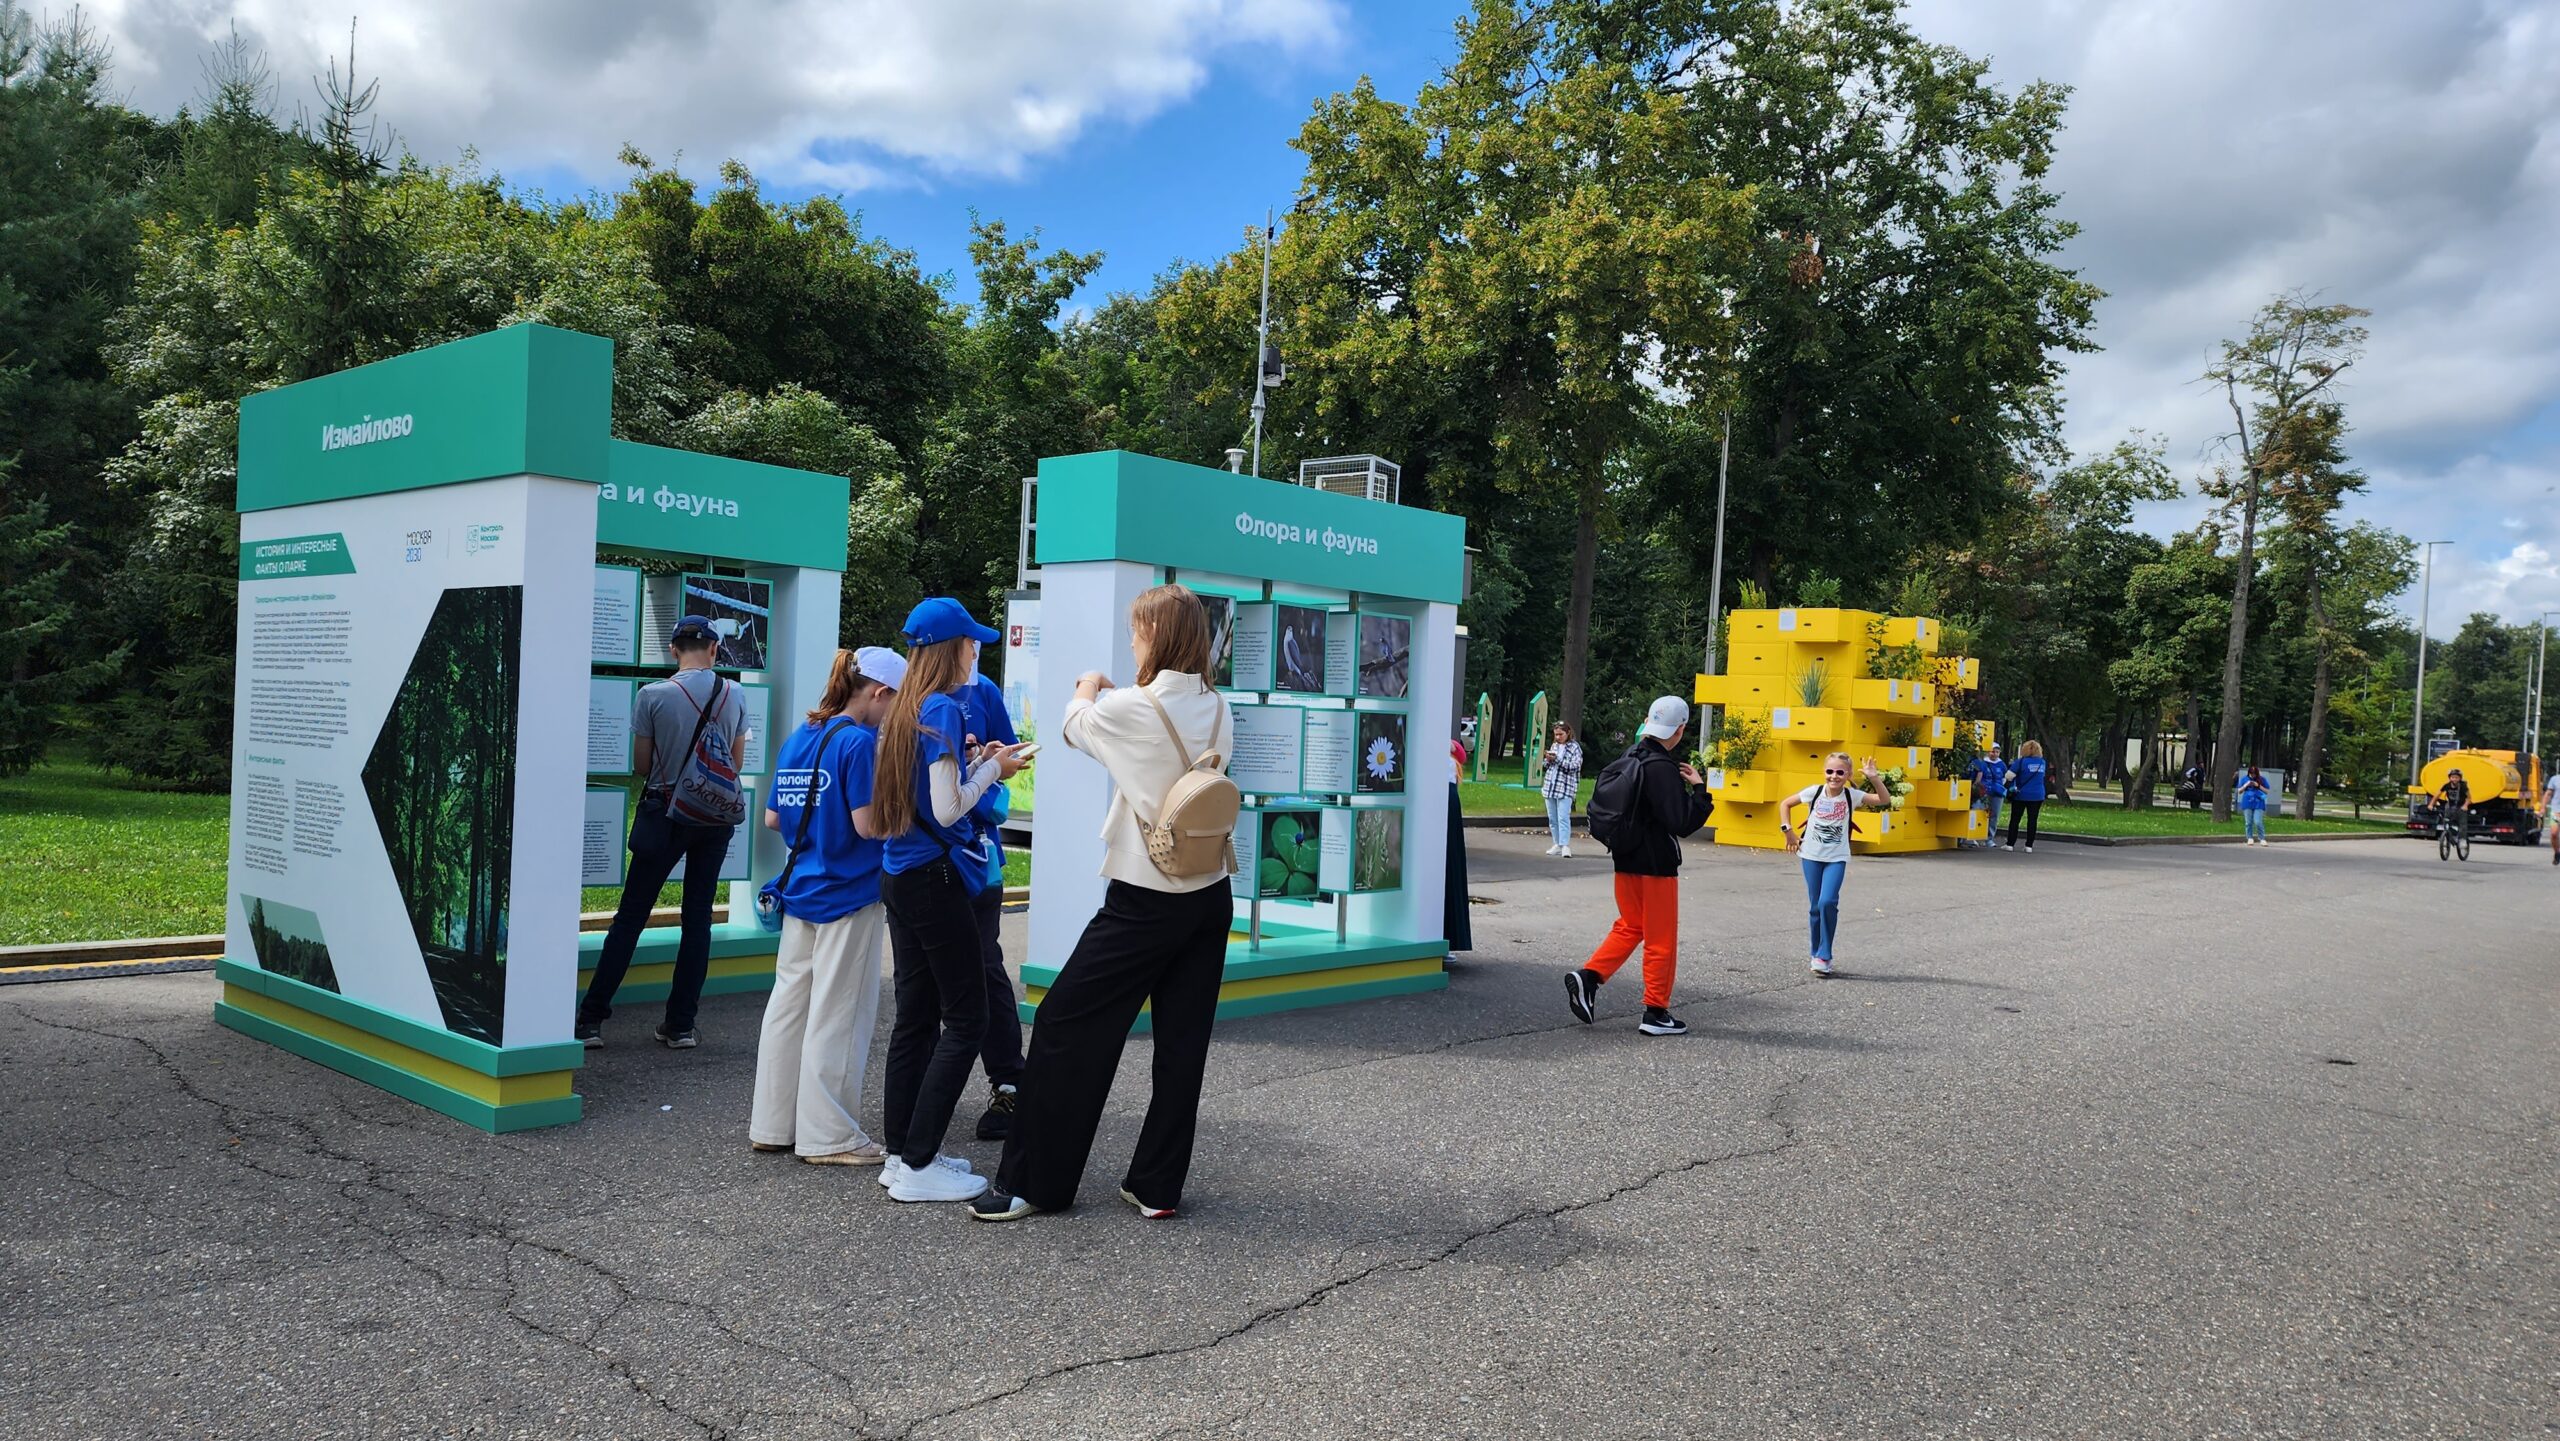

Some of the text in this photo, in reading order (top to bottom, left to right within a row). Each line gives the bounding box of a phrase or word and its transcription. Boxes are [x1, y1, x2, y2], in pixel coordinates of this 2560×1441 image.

[322, 414, 413, 451] Измайлово
[627, 485, 645, 504] и
[653, 485, 739, 517] фауна
[406, 530, 432, 546] МОСКВА
[1235, 511, 1378, 556] Флора и фауна
[256, 539, 338, 558] ИСТОРИЯ И ИНТЕРЕСНЫЕ
[406, 547, 422, 563] 2030
[255, 560, 307, 575] ФАКТЫ О ПАРКЕ
